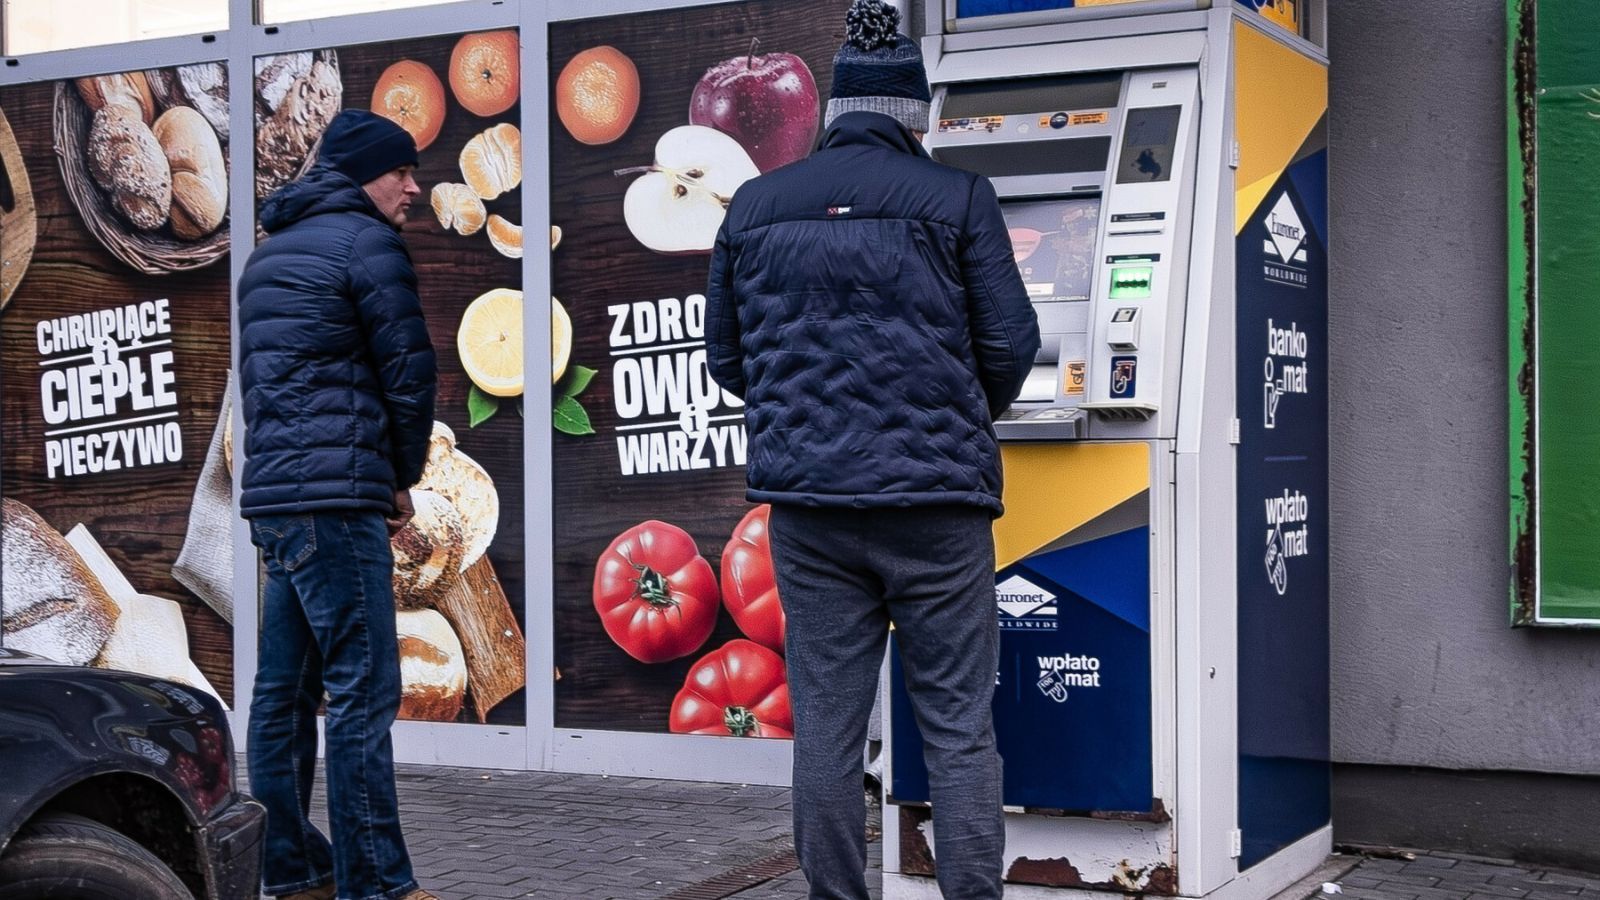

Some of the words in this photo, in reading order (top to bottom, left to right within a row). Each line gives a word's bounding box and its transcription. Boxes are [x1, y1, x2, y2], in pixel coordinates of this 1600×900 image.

[1263, 265, 1308, 284] WORLDWIDE
[36, 298, 172, 355] CHRUPIĄCE
[607, 293, 707, 347] ZDRO
[1267, 318, 1307, 358] banko
[40, 350, 178, 424] CIEPŁE
[612, 348, 746, 419] OWO
[1283, 361, 1308, 393] mat
[45, 421, 183, 479] PIECZYWO
[616, 423, 749, 476] WARZYW
[1265, 488, 1308, 527] wpłato
[1284, 523, 1308, 558] mat
[1037, 653, 1100, 673] wpłato
[1065, 671, 1101, 687] mat
